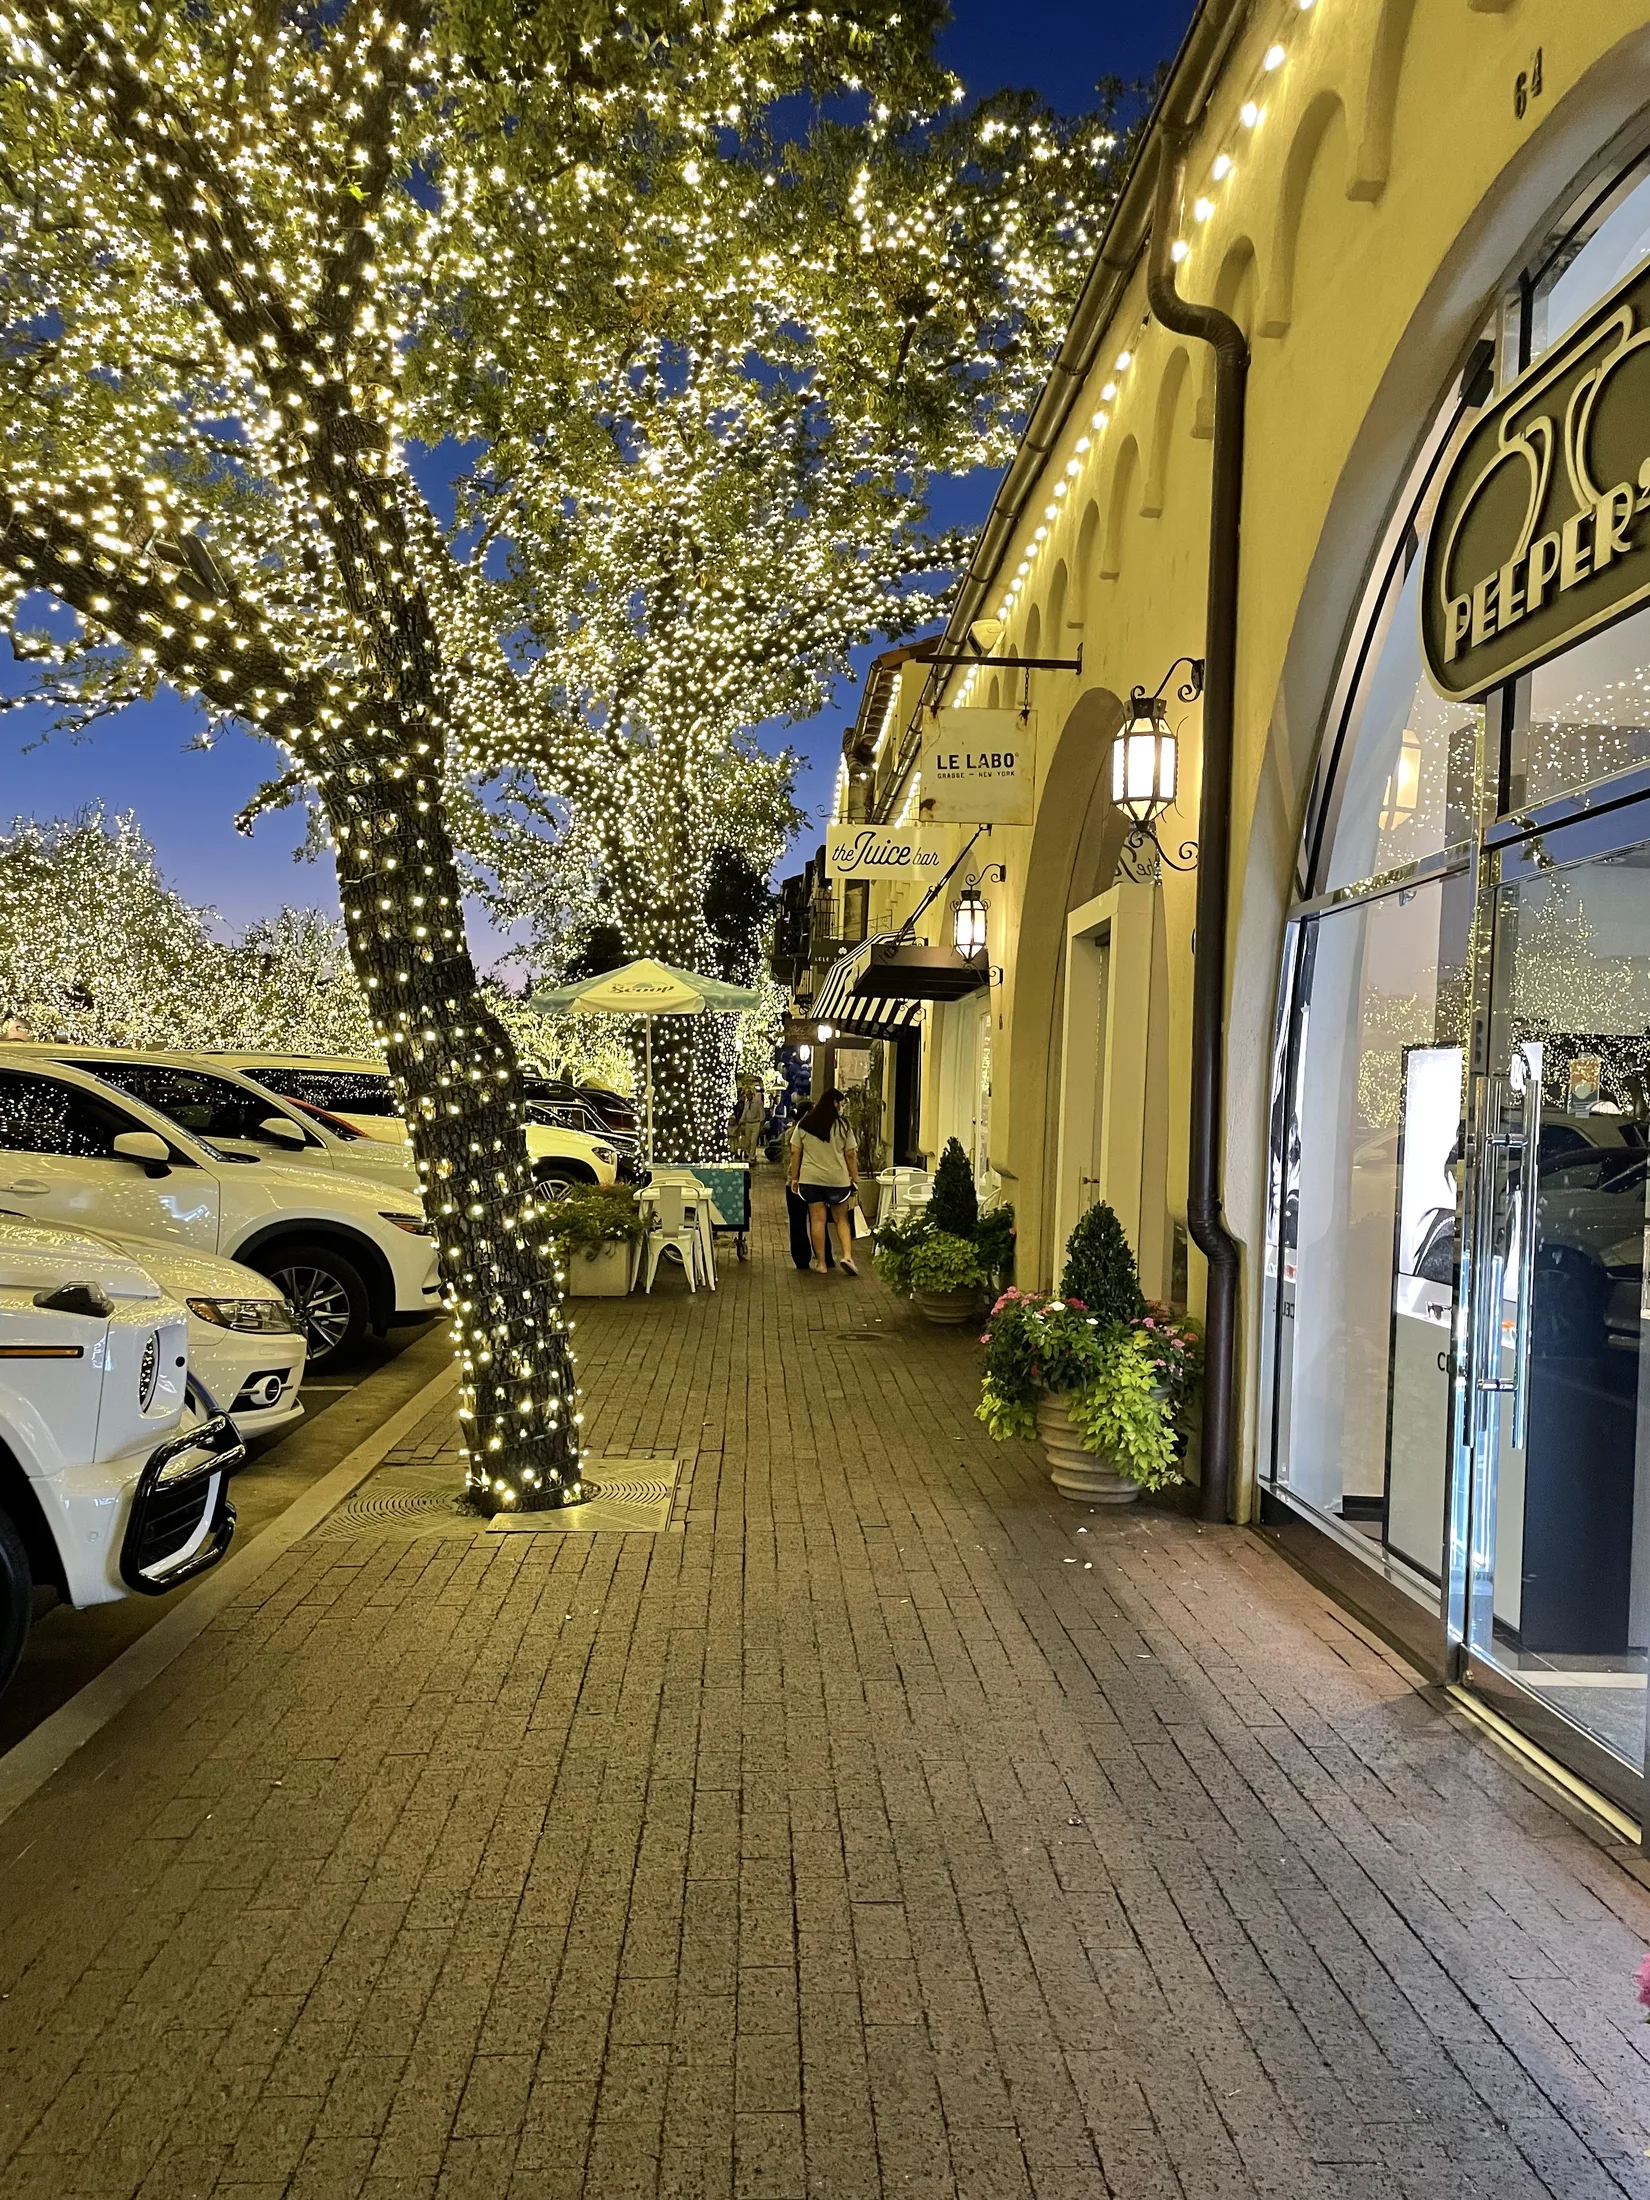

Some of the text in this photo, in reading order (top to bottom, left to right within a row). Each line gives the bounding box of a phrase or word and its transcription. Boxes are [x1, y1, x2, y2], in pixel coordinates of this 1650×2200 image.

[1513, 45, 1542, 120] 64
[937, 753, 1015, 769] LE LABO
[832, 831, 939, 872] the Juice bar
[610, 985, 675, 994] Scoop
